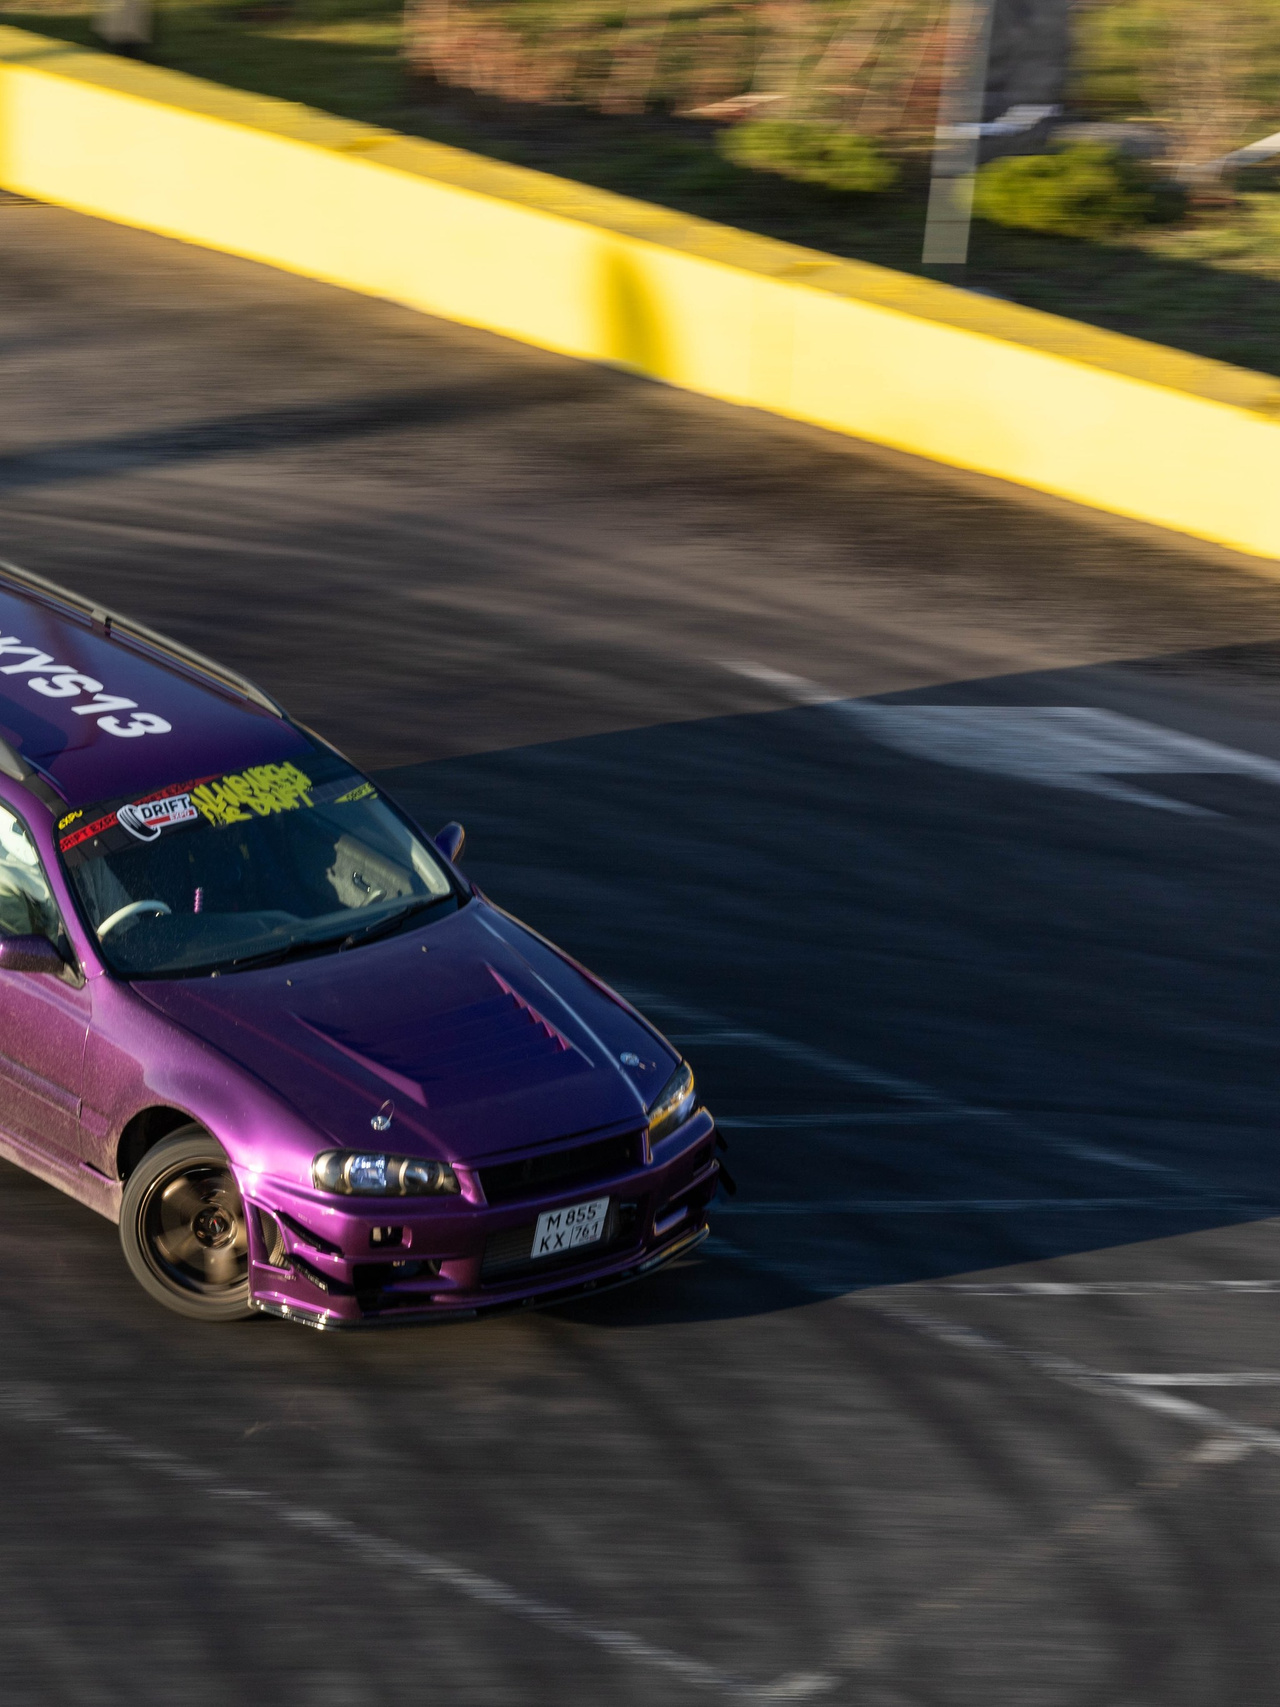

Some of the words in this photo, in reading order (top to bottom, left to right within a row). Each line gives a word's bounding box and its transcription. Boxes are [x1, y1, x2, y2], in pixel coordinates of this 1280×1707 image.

[141, 797, 187, 819] DRIFT
[547, 1213, 562, 1233] M
[565, 1203, 597, 1226] 855
[540, 1231, 566, 1253] KX
[575, 1220, 599, 1240] 761
